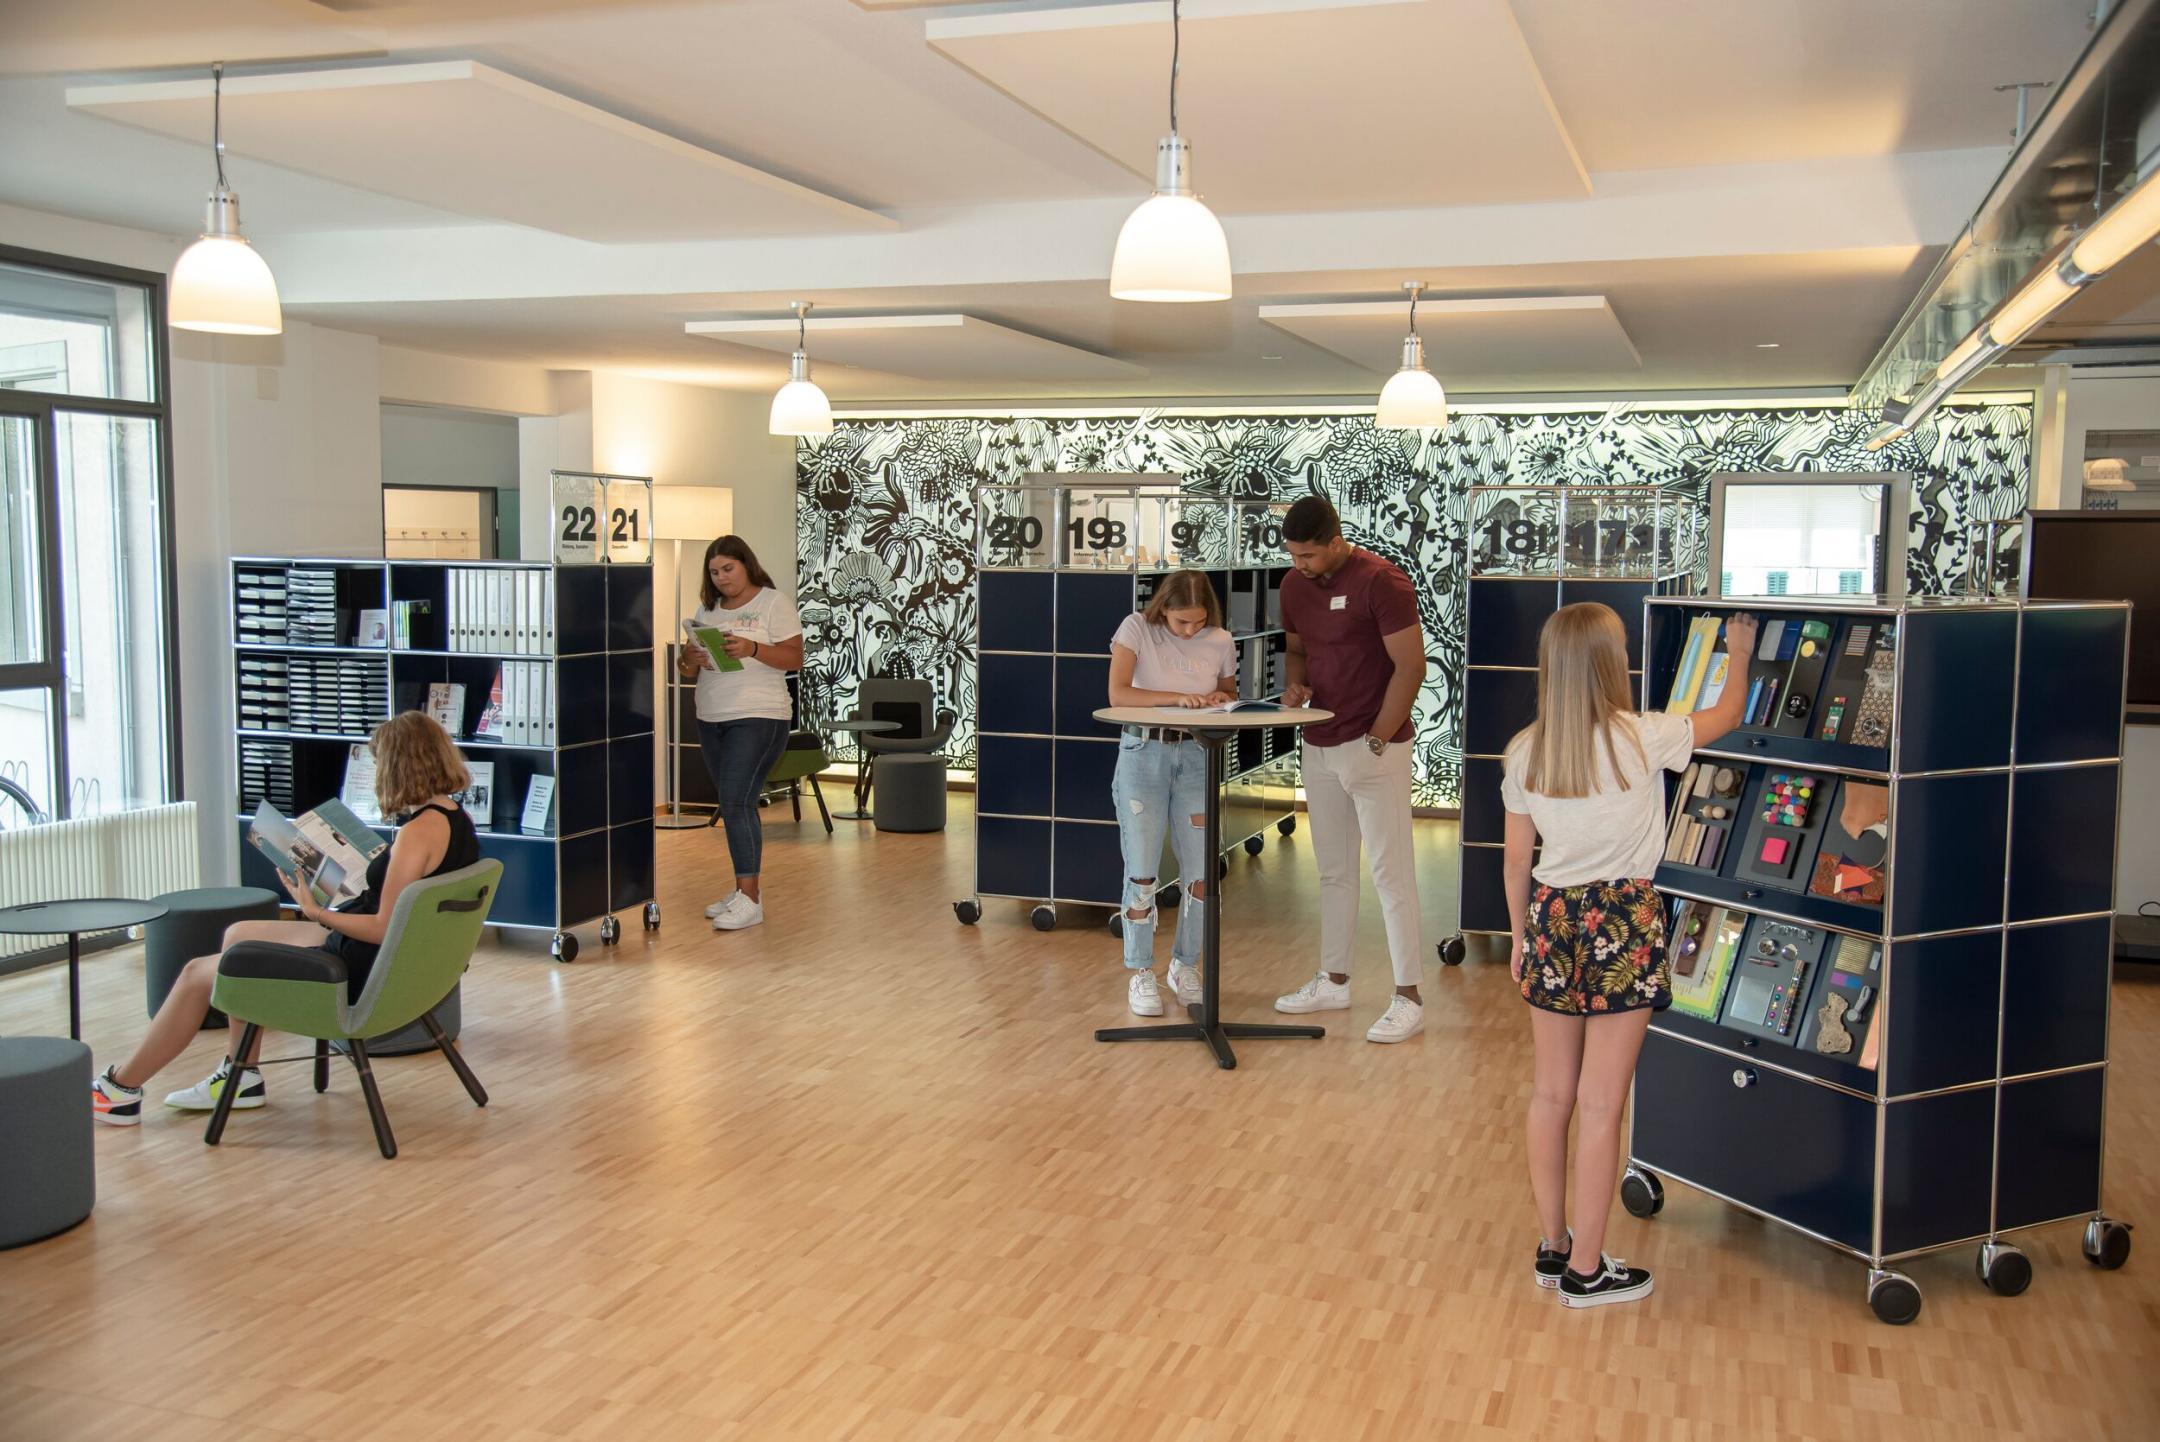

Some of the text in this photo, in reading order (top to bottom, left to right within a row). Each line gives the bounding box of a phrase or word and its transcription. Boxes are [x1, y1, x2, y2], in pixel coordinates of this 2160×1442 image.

[562, 505, 597, 541] 22
[612, 507, 639, 542] 21
[990, 516, 1043, 549] 20
[1068, 517, 1113, 550] 19
[1247, 524, 1282, 549] 10
[1483, 519, 1537, 555] 18
